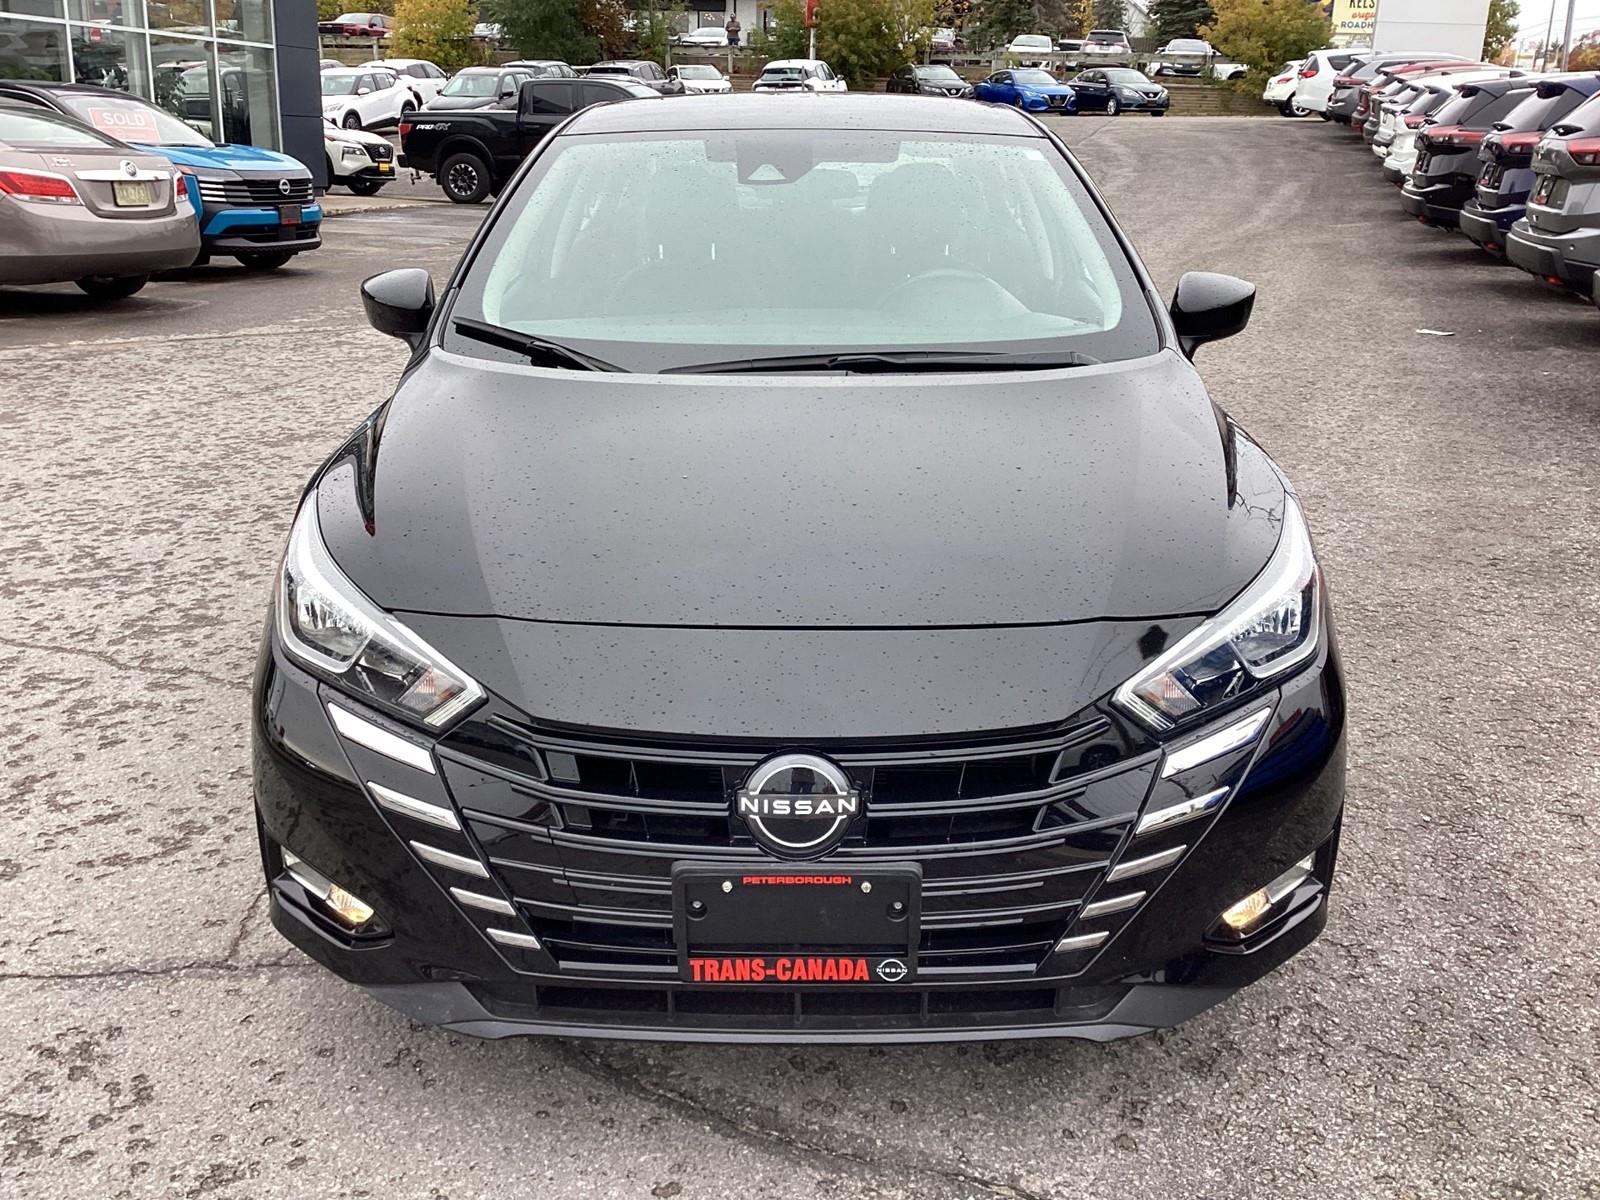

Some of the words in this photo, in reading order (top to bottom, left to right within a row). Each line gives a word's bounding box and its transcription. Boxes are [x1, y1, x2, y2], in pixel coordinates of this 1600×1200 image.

[103, 112, 145, 126] SOLD
[741, 797, 856, 815] NISSAN
[743, 876, 852, 885] PETERBOROUGH
[690, 959, 869, 981] TRANS-CANADA
[877, 966, 908, 974] NISSAN
